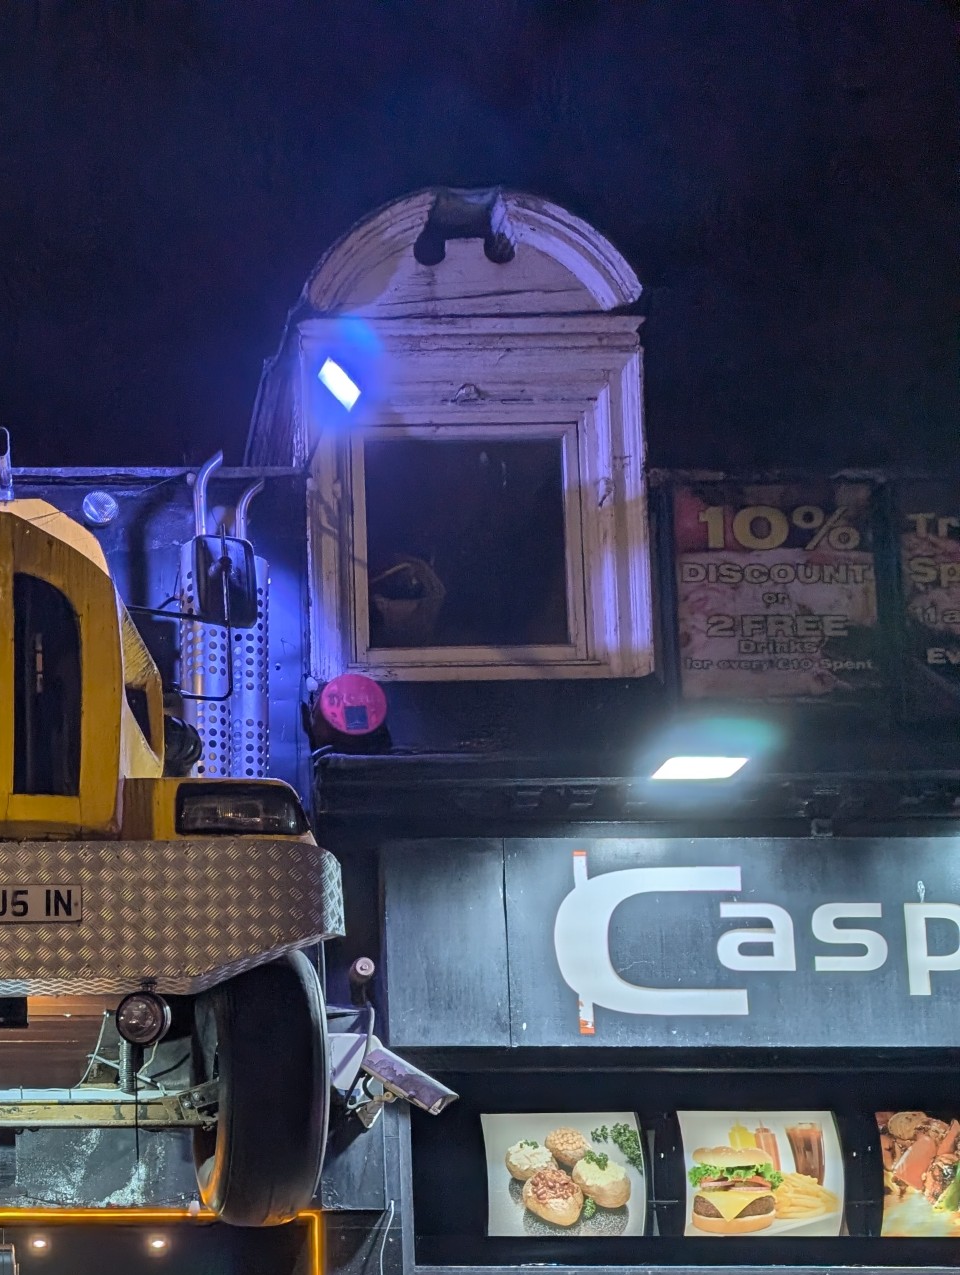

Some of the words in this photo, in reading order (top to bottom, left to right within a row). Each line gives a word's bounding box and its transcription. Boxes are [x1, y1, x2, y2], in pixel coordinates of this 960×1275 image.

[697, 505, 861, 550] 10%
[680, 563, 872, 584] DISCOUNT
[762, 591, 789, 604] or
[707, 614, 736, 637] 2
[740, 614, 848, 637] FREE
[739, 640, 821, 653] Drinks
[717, 659, 769, 672] every
[820, 658, 873, 672] Spent
[45, 889, 72, 917] IN
